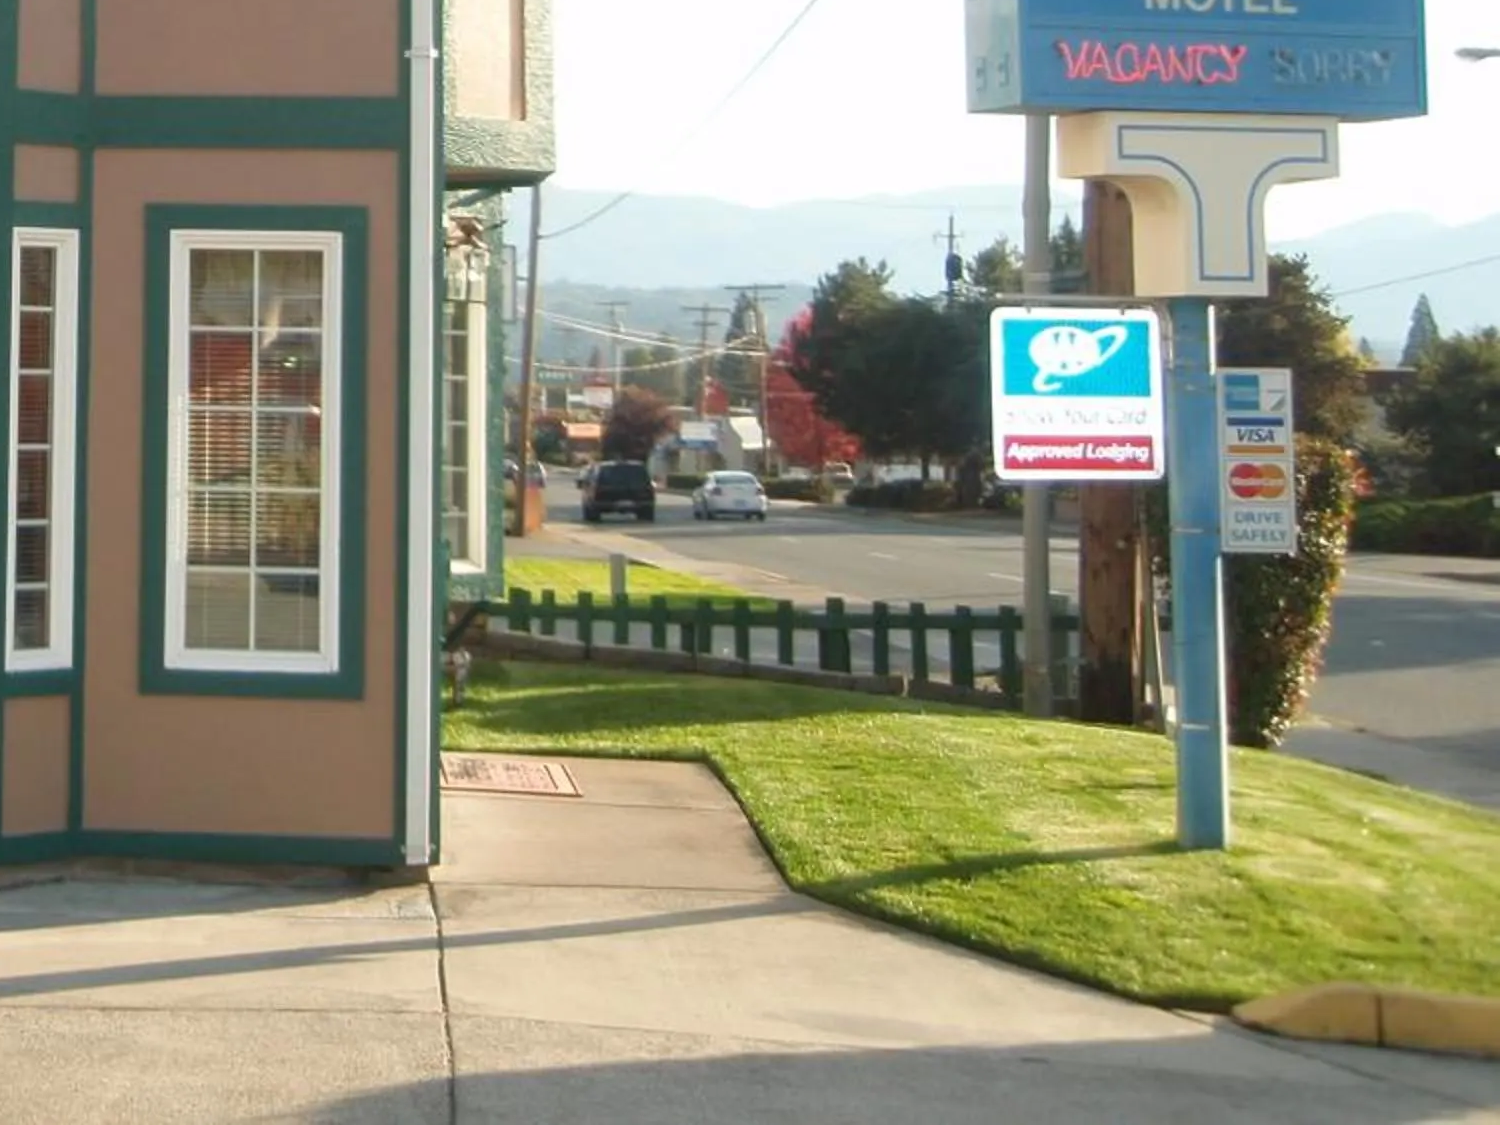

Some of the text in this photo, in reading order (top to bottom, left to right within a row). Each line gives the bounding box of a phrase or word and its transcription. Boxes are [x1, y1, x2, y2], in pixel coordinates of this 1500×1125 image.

[1056, 39, 1397, 86] VACANCY SORRY
[1236, 428, 1276, 443] VISA
[1007, 442, 1150, 463] Approved Lodging
[1234, 510, 1285, 525] DRIVE
[1231, 528, 1288, 543] SAFELY
